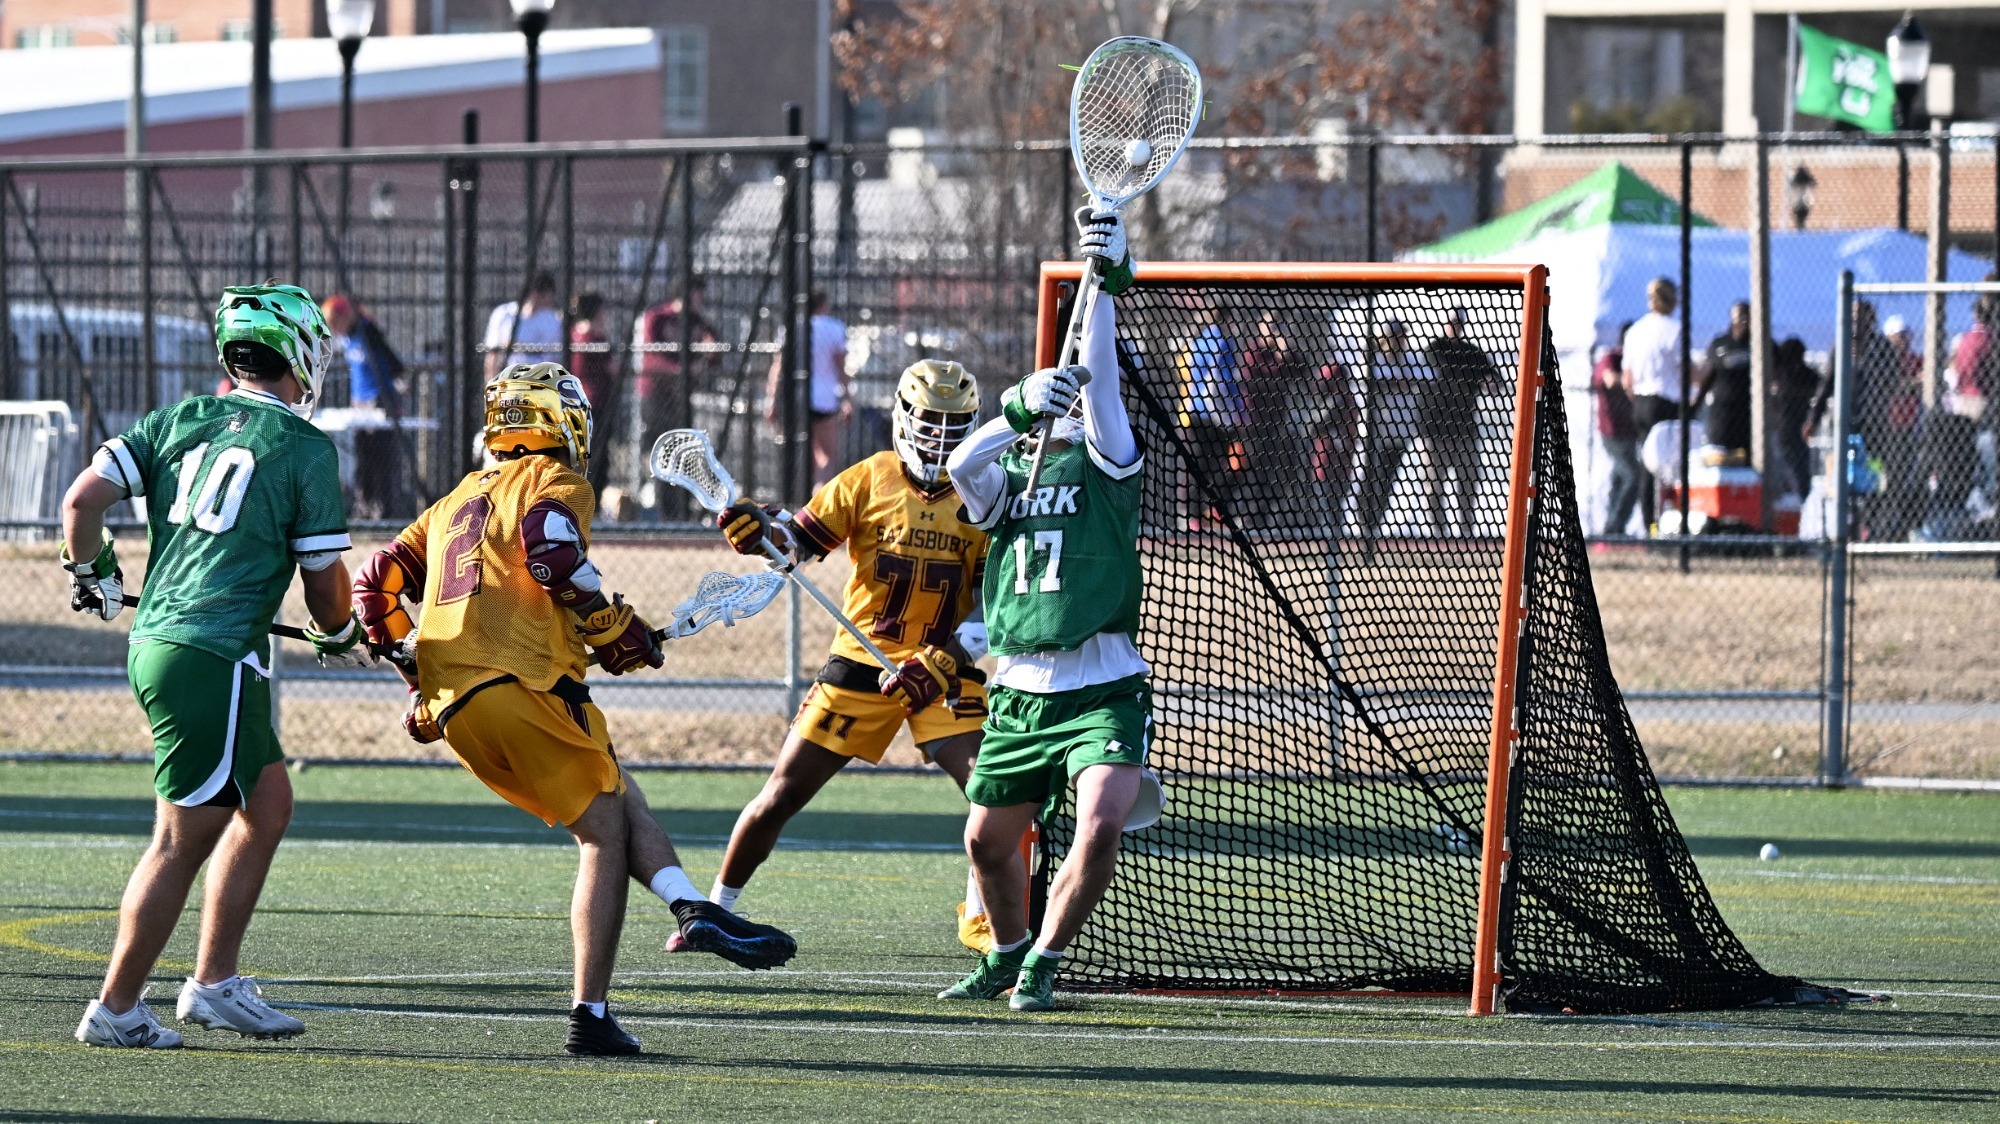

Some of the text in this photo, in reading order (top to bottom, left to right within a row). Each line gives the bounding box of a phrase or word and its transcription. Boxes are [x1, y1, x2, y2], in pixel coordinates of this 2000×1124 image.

[166, 441, 257, 534] 10
[1004, 486, 1081, 519] ORK
[436, 493, 493, 606] 2
[876, 525, 973, 555] SALISBURY
[1013, 530, 1064, 595] 17
[869, 549, 963, 648] 77
